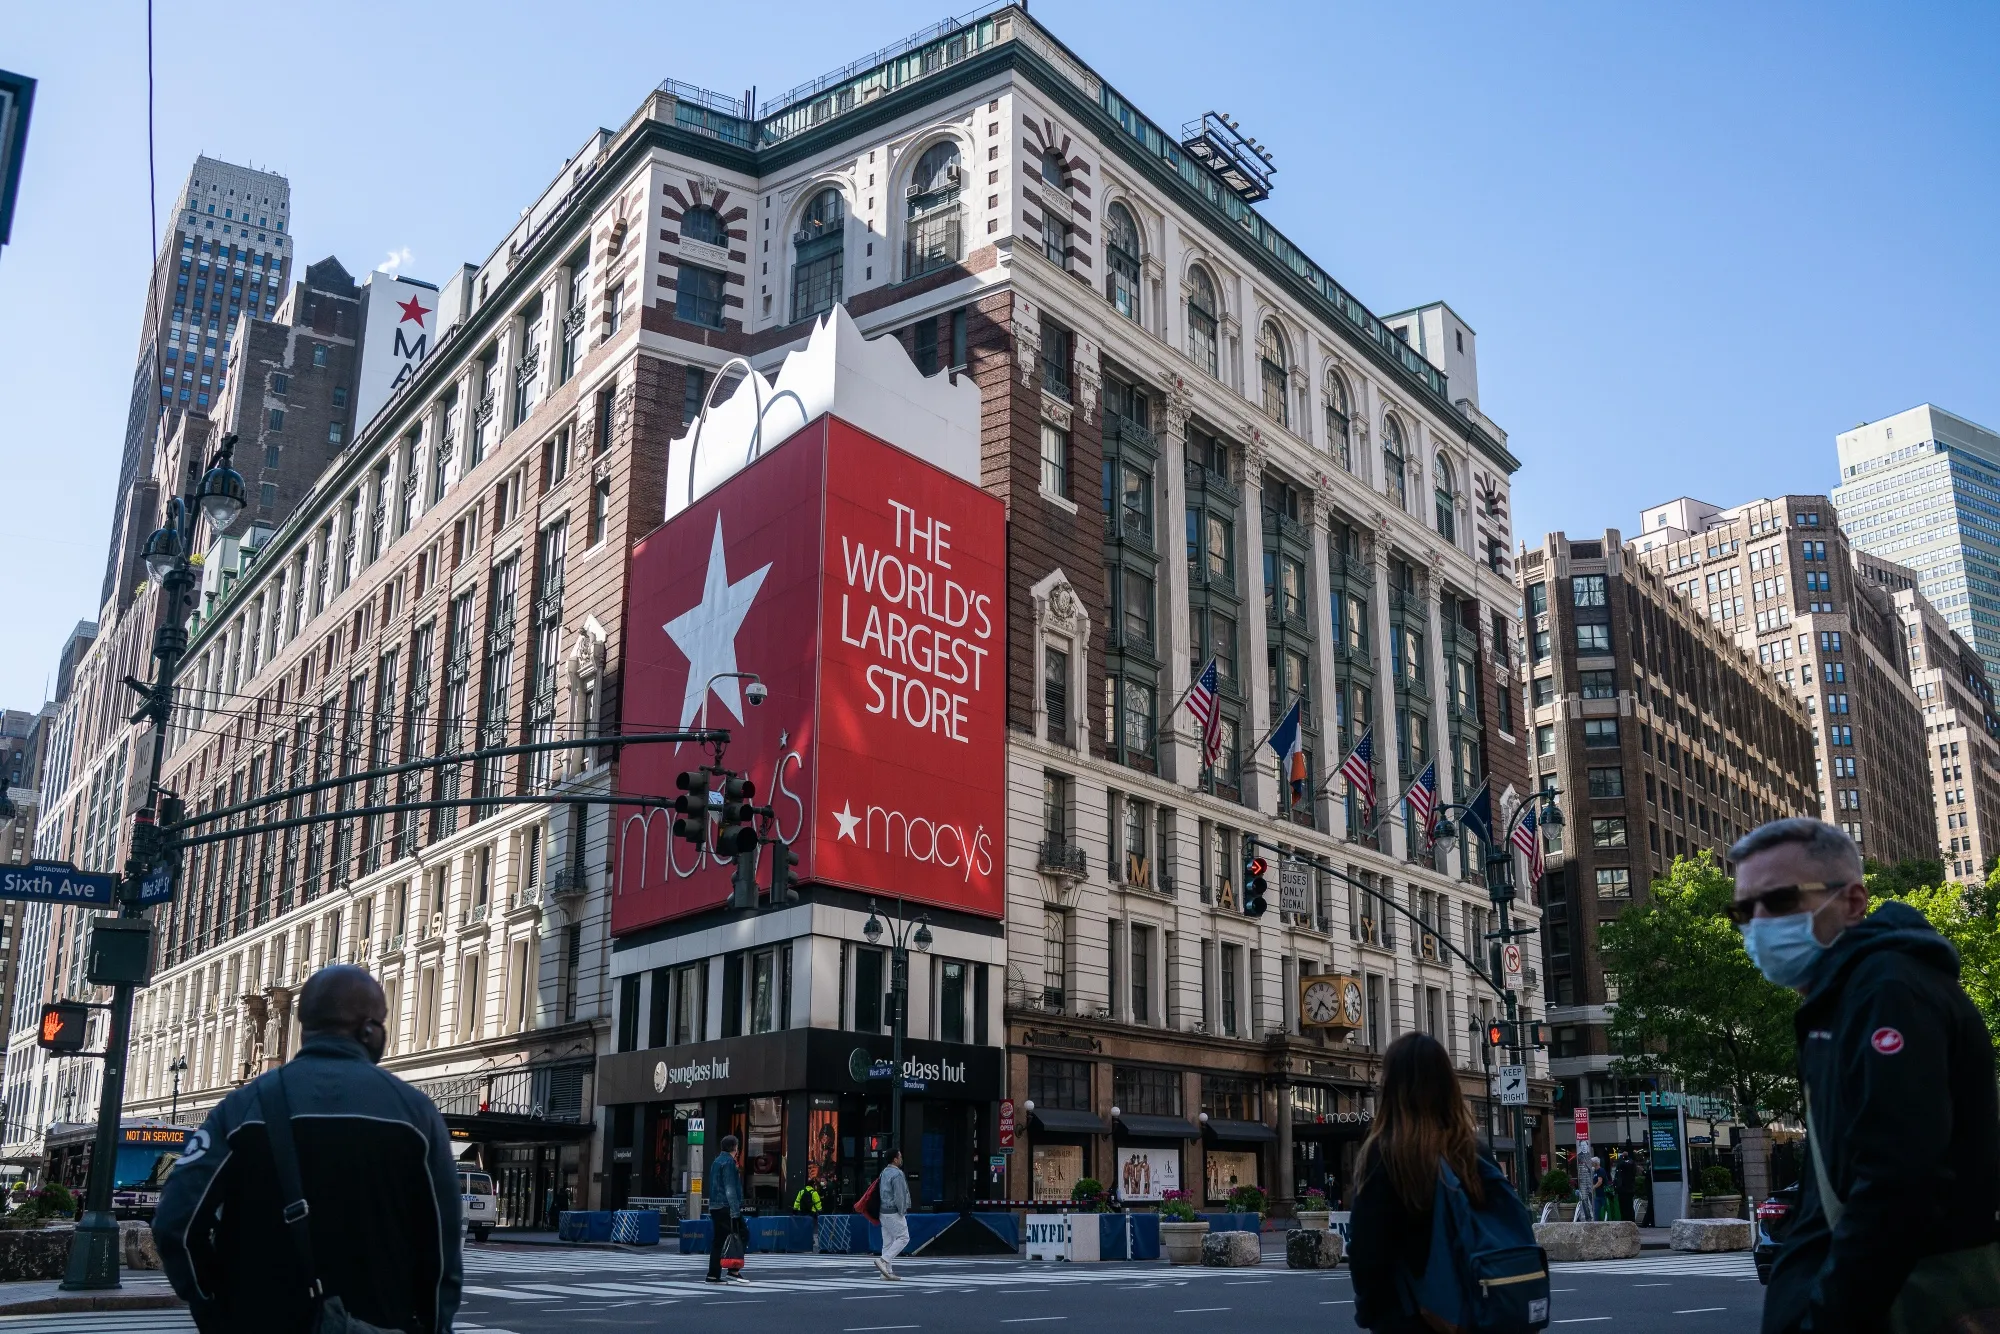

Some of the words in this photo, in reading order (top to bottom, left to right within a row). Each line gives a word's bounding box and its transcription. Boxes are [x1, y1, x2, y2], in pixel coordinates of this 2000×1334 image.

[888, 498, 952, 571] THE
[841, 535, 992, 640] WORLD'S
[841, 594, 989, 691] LARGEST
[865, 664, 970, 744] STORE
[137, 741, 150, 770] NO
[866, 804, 992, 883] macy's
[34, 865, 71, 874] BROADWAY
[4, 874, 56, 893] Sixth
[58, 878, 96, 898] Ave
[141, 881, 154, 899] West
[163, 876, 170, 893] St
[1282, 873, 1307, 886] BUSES
[1283, 886, 1305, 898] ONLY
[1281, 898, 1305, 911] SIGNAL
[669, 1059, 711, 1089] sunglass
[712, 1056, 730, 1080] hut
[869, 1068, 879, 1077] West
[886, 1067, 892, 1075] St
[942, 1058, 966, 1083] hut
[1503, 1068, 1522, 1077] KEEP
[903, 1081, 925, 1091] Broadway
[1502, 1092, 1525, 1101] RIGHT
[1325, 1108, 1370, 1126] macy's
[125, 1130, 140, 1141] NOT
[142, 1130, 151, 1141] IN
[153, 1131, 185, 1142] SERVICE
[1031, 1224, 1065, 1243] NYPD
